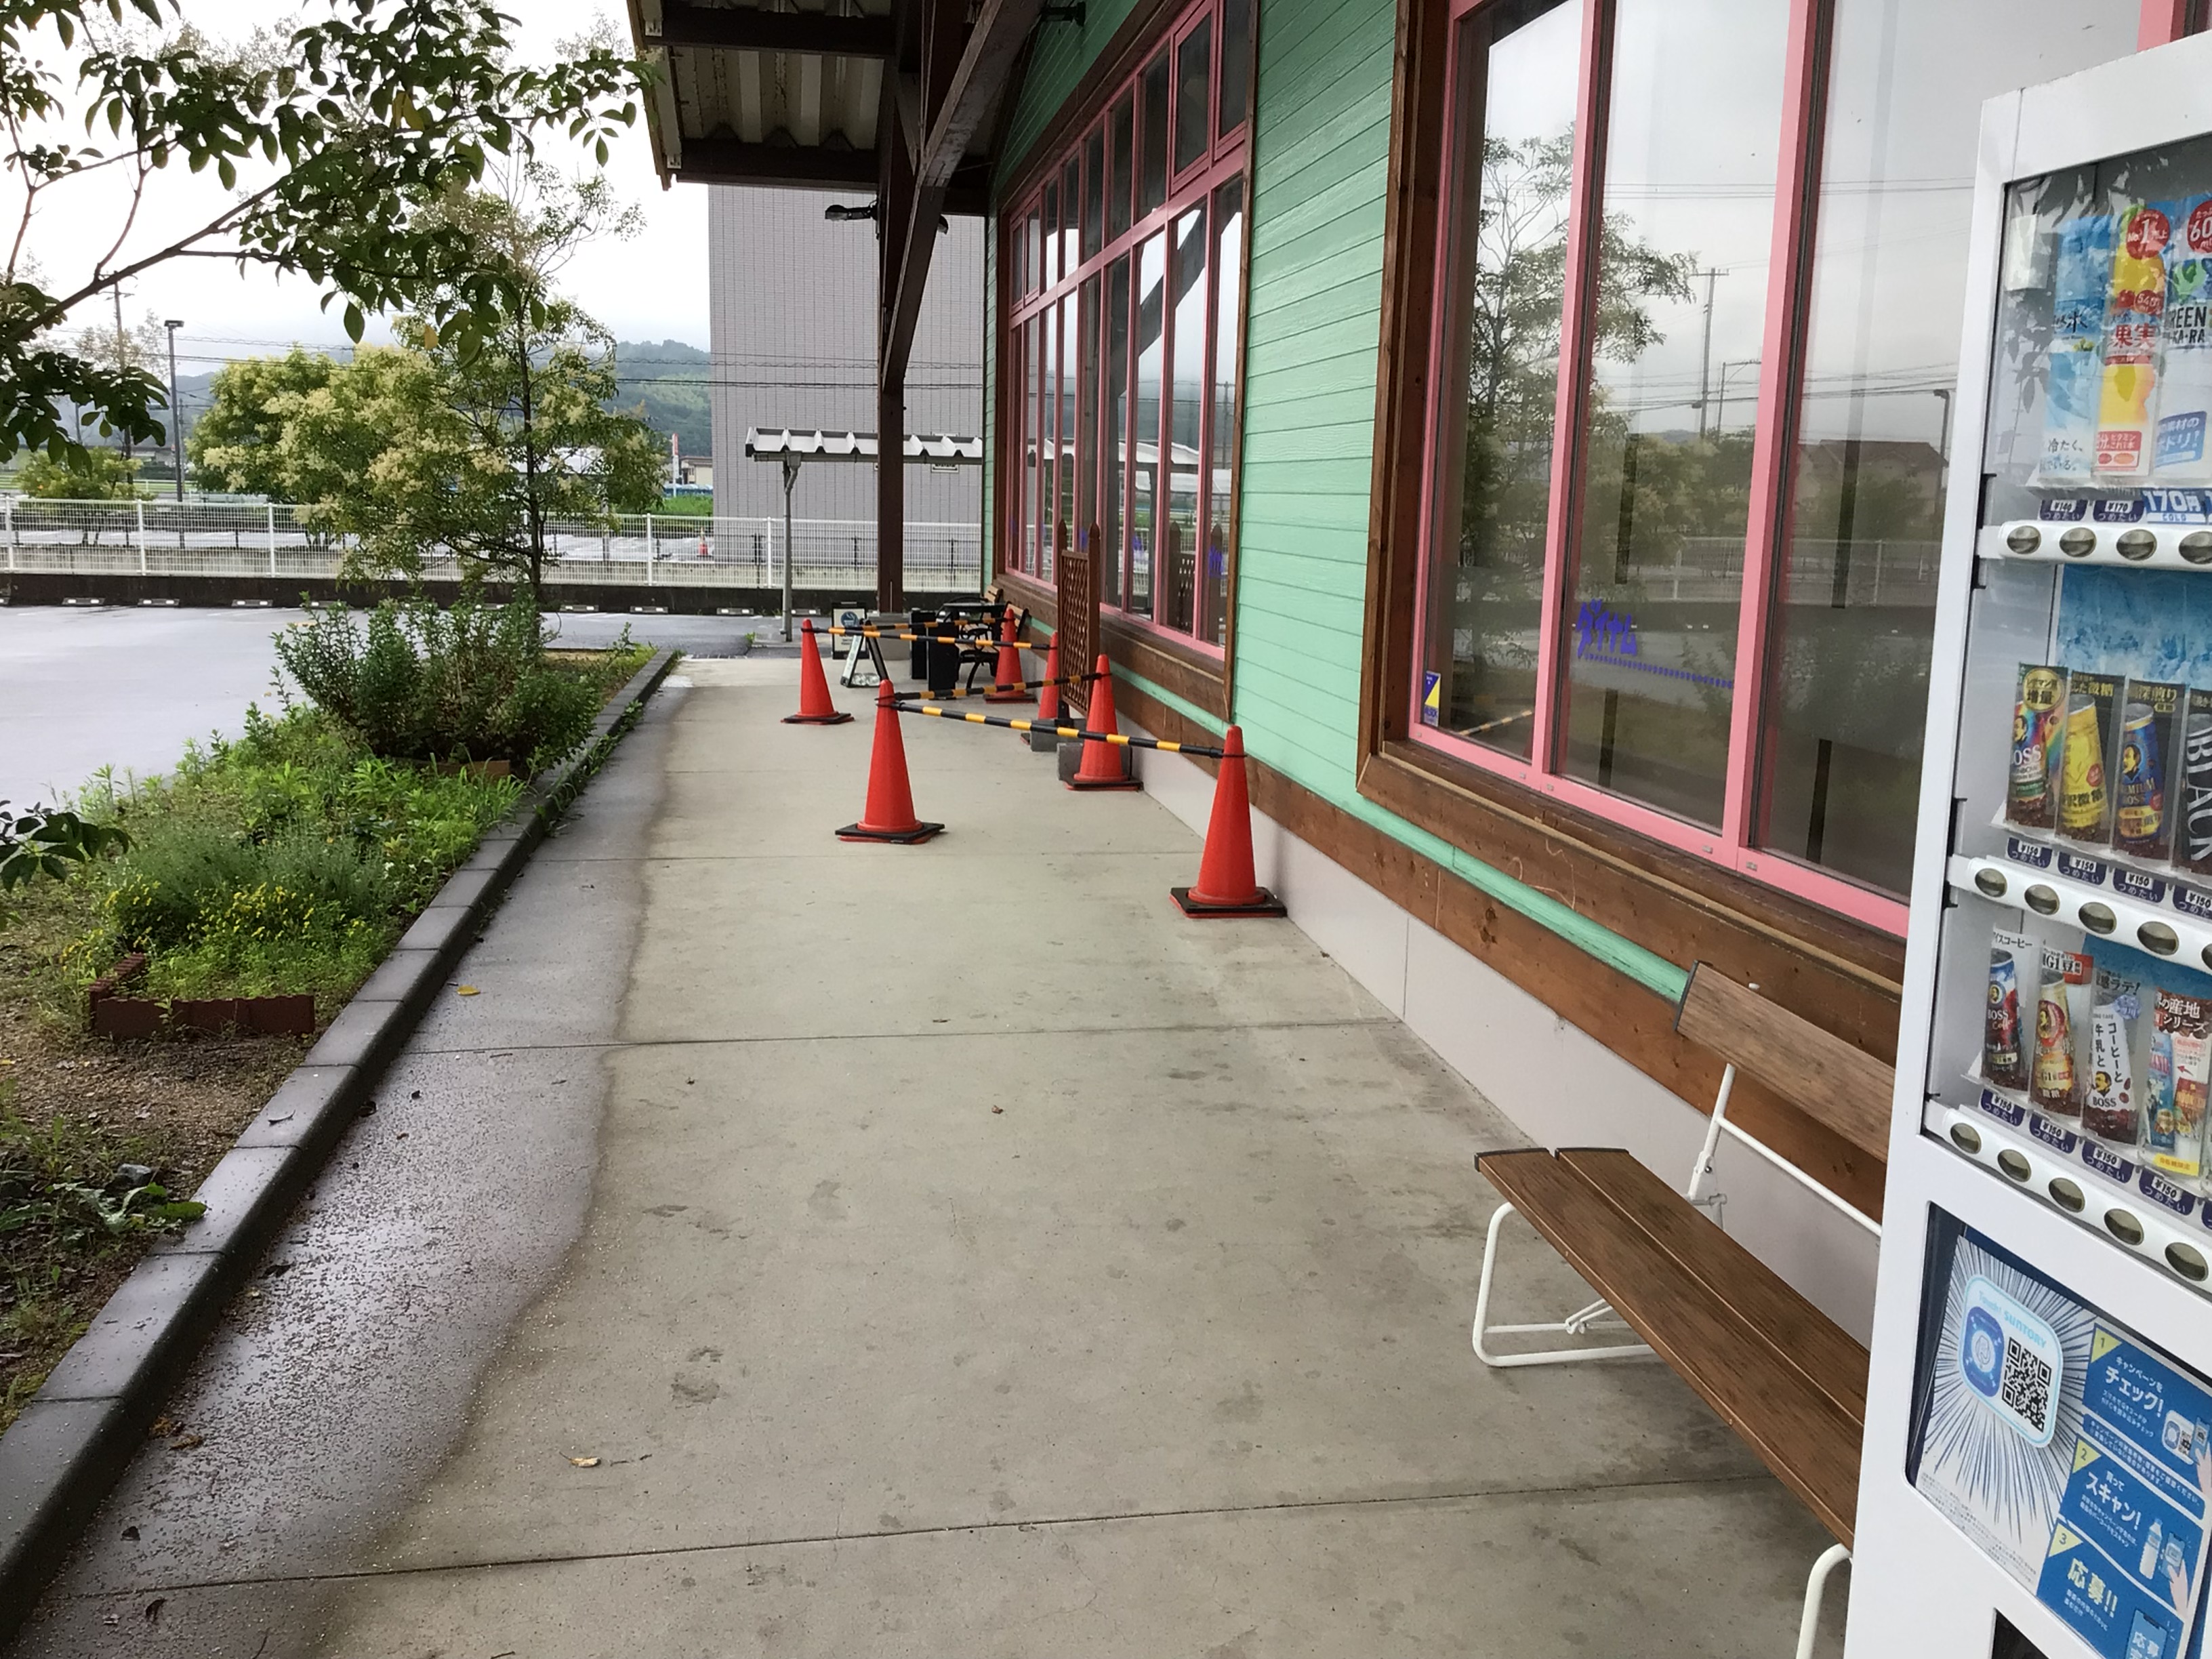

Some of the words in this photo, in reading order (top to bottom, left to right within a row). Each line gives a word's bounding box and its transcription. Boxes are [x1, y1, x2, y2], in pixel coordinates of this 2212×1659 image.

[2167, 306, 2207, 329] REEN
[2107, 323, 2156, 348] 果実
[2143, 490, 2201, 512] 170円
[2044, 512, 2080, 520] つめたい
[2099, 513, 2137, 521] つめたい
[2163, 513, 2187, 521] COLD
[2026, 690, 2055, 705] 増量
[2013, 744, 2042, 766] OSS
[2021, 842, 2039, 856] ¥150
[2011, 850, 2045, 868] つめたい
[2074, 859, 2095, 871] ¥150
[2063, 865, 2100, 884] つめたい
[2129, 874, 2150, 886] ¥150
[2118, 883, 2158, 901] つめたい
[2190, 893, 2211, 908] ¥150
[2095, 1023, 2106, 1068] 牛乳と
[1994, 1095, 2011, 1111] ¥150
[2093, 1097, 2117, 1107] BOSS
[1984, 1103, 2018, 1124] つめたい
[2043, 1122, 2062, 1137] ¥150
[2034, 1128, 2069, 1151] つめたい
[2095, 1149, 2117, 1165] ¥150
[2086, 1155, 2125, 1181] つめたい
[2155, 1179, 2177, 1198] ¥150
[2145, 1186, 2186, 1213] つめたい
[2101, 1337, 2106, 1349] 1
[2116, 1356, 2163, 1393] キャンペーンを
[2105, 1366, 2164, 1418] チェック!
[2081, 1448, 2087, 1461] 2
[2085, 1471, 2141, 1530] スキャン!
[2059, 1533, 2067, 1545] 3
[2067, 1558, 2118, 1618] 応募!!
